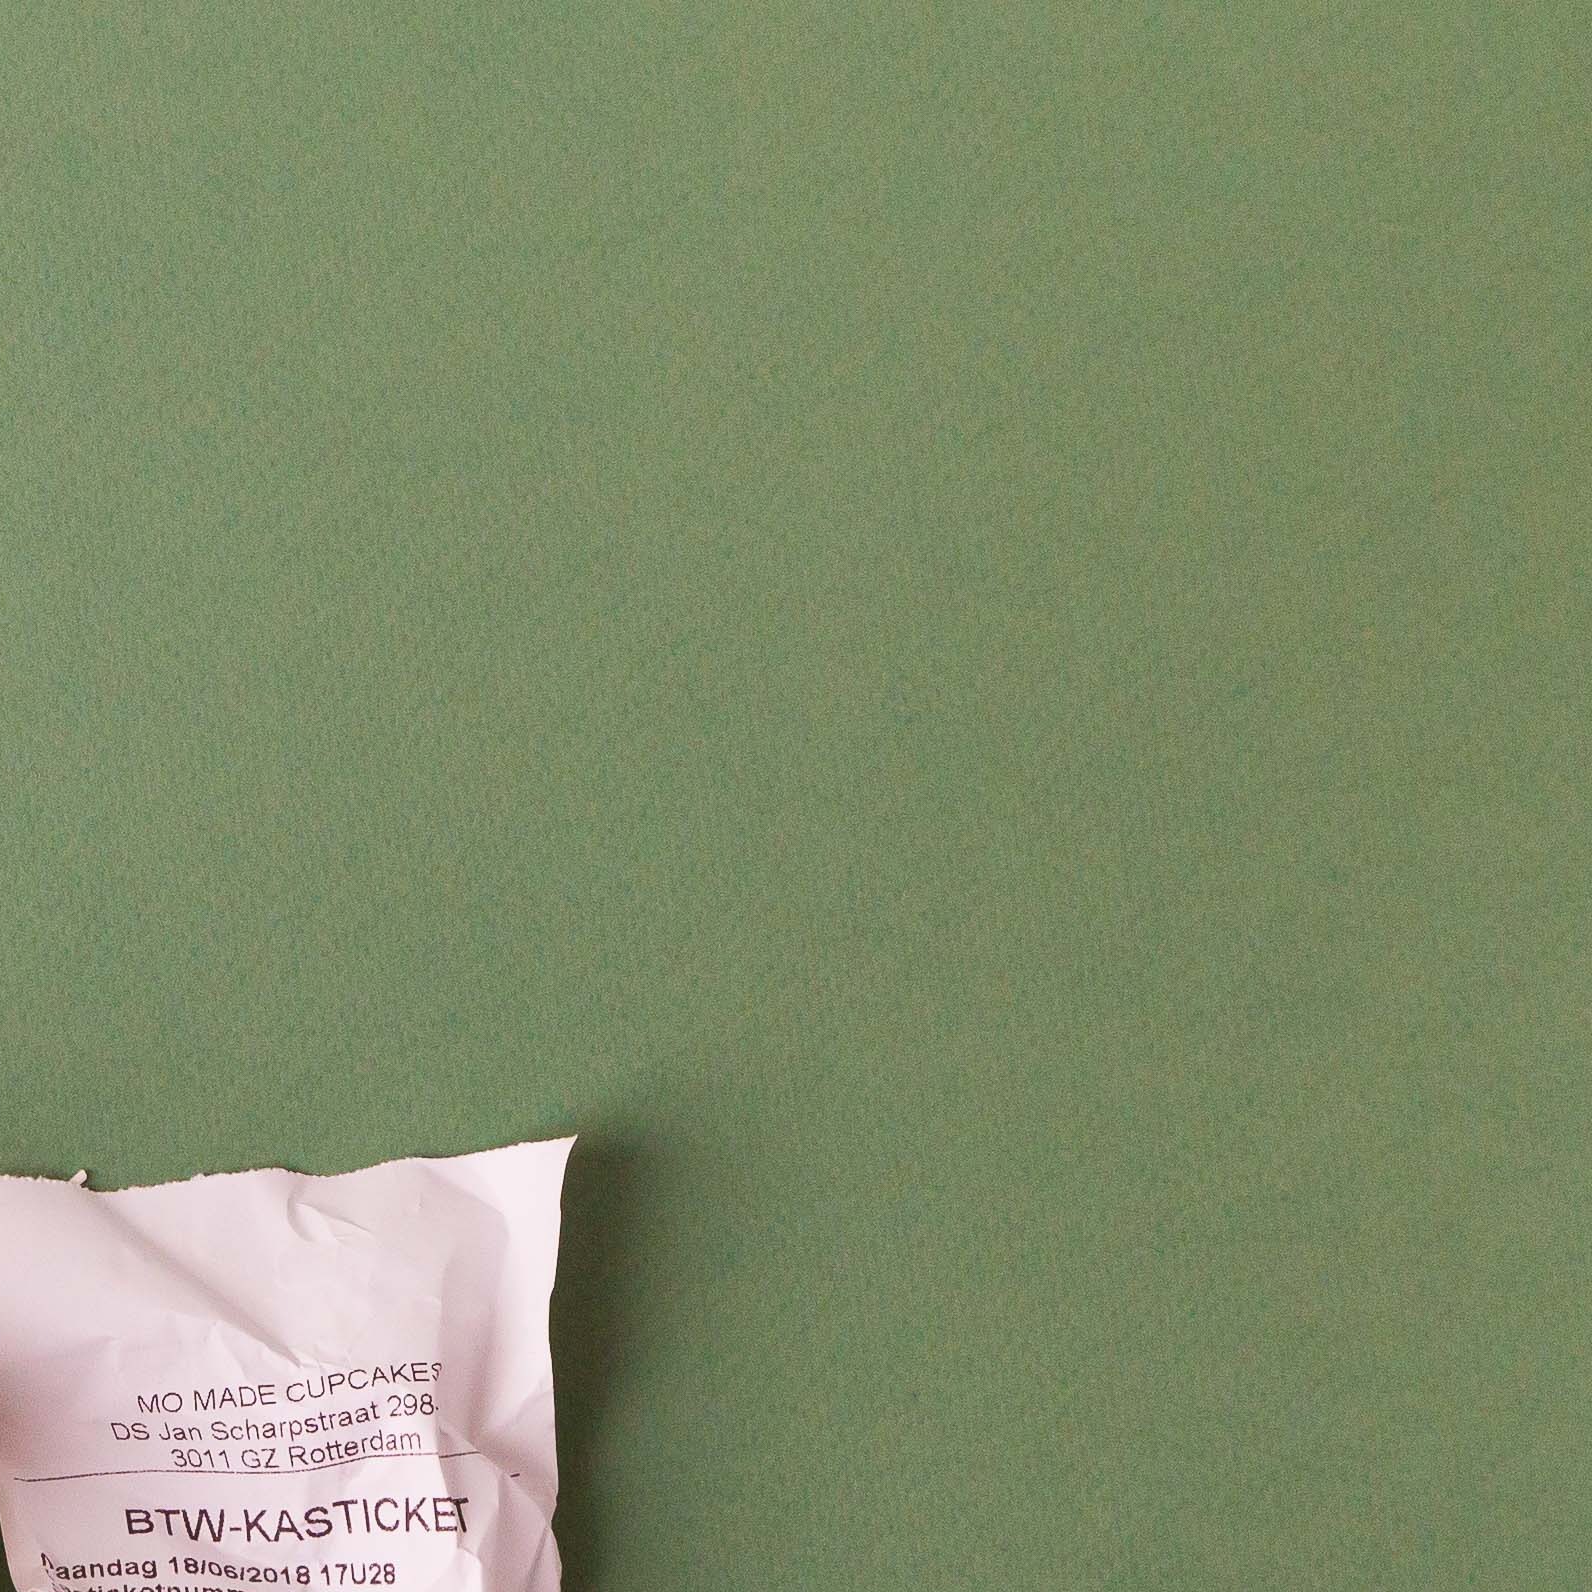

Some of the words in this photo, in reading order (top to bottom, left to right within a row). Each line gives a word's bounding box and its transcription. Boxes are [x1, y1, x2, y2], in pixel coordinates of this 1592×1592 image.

[136, 1392, 183, 1414] MO
[193, 1384, 277, 1412] MADE
[285, 1362, 443, 1403] CUPCAKES
[110, 1422, 150, 1441] DS
[158, 1423, 203, 1442] Jan
[210, 1401, 381, 1442] Scharpstraat
[171, 1448, 232, 1470] 3011
[240, 1449, 280, 1470] GZ
[288, 1429, 423, 1468] Rotterdam
[124, 1497, 470, 1543] BTW-KASTICKET
[168, 1556, 311, 1586] 18/06/2018
[320, 1562, 396, 1586] 17U28
